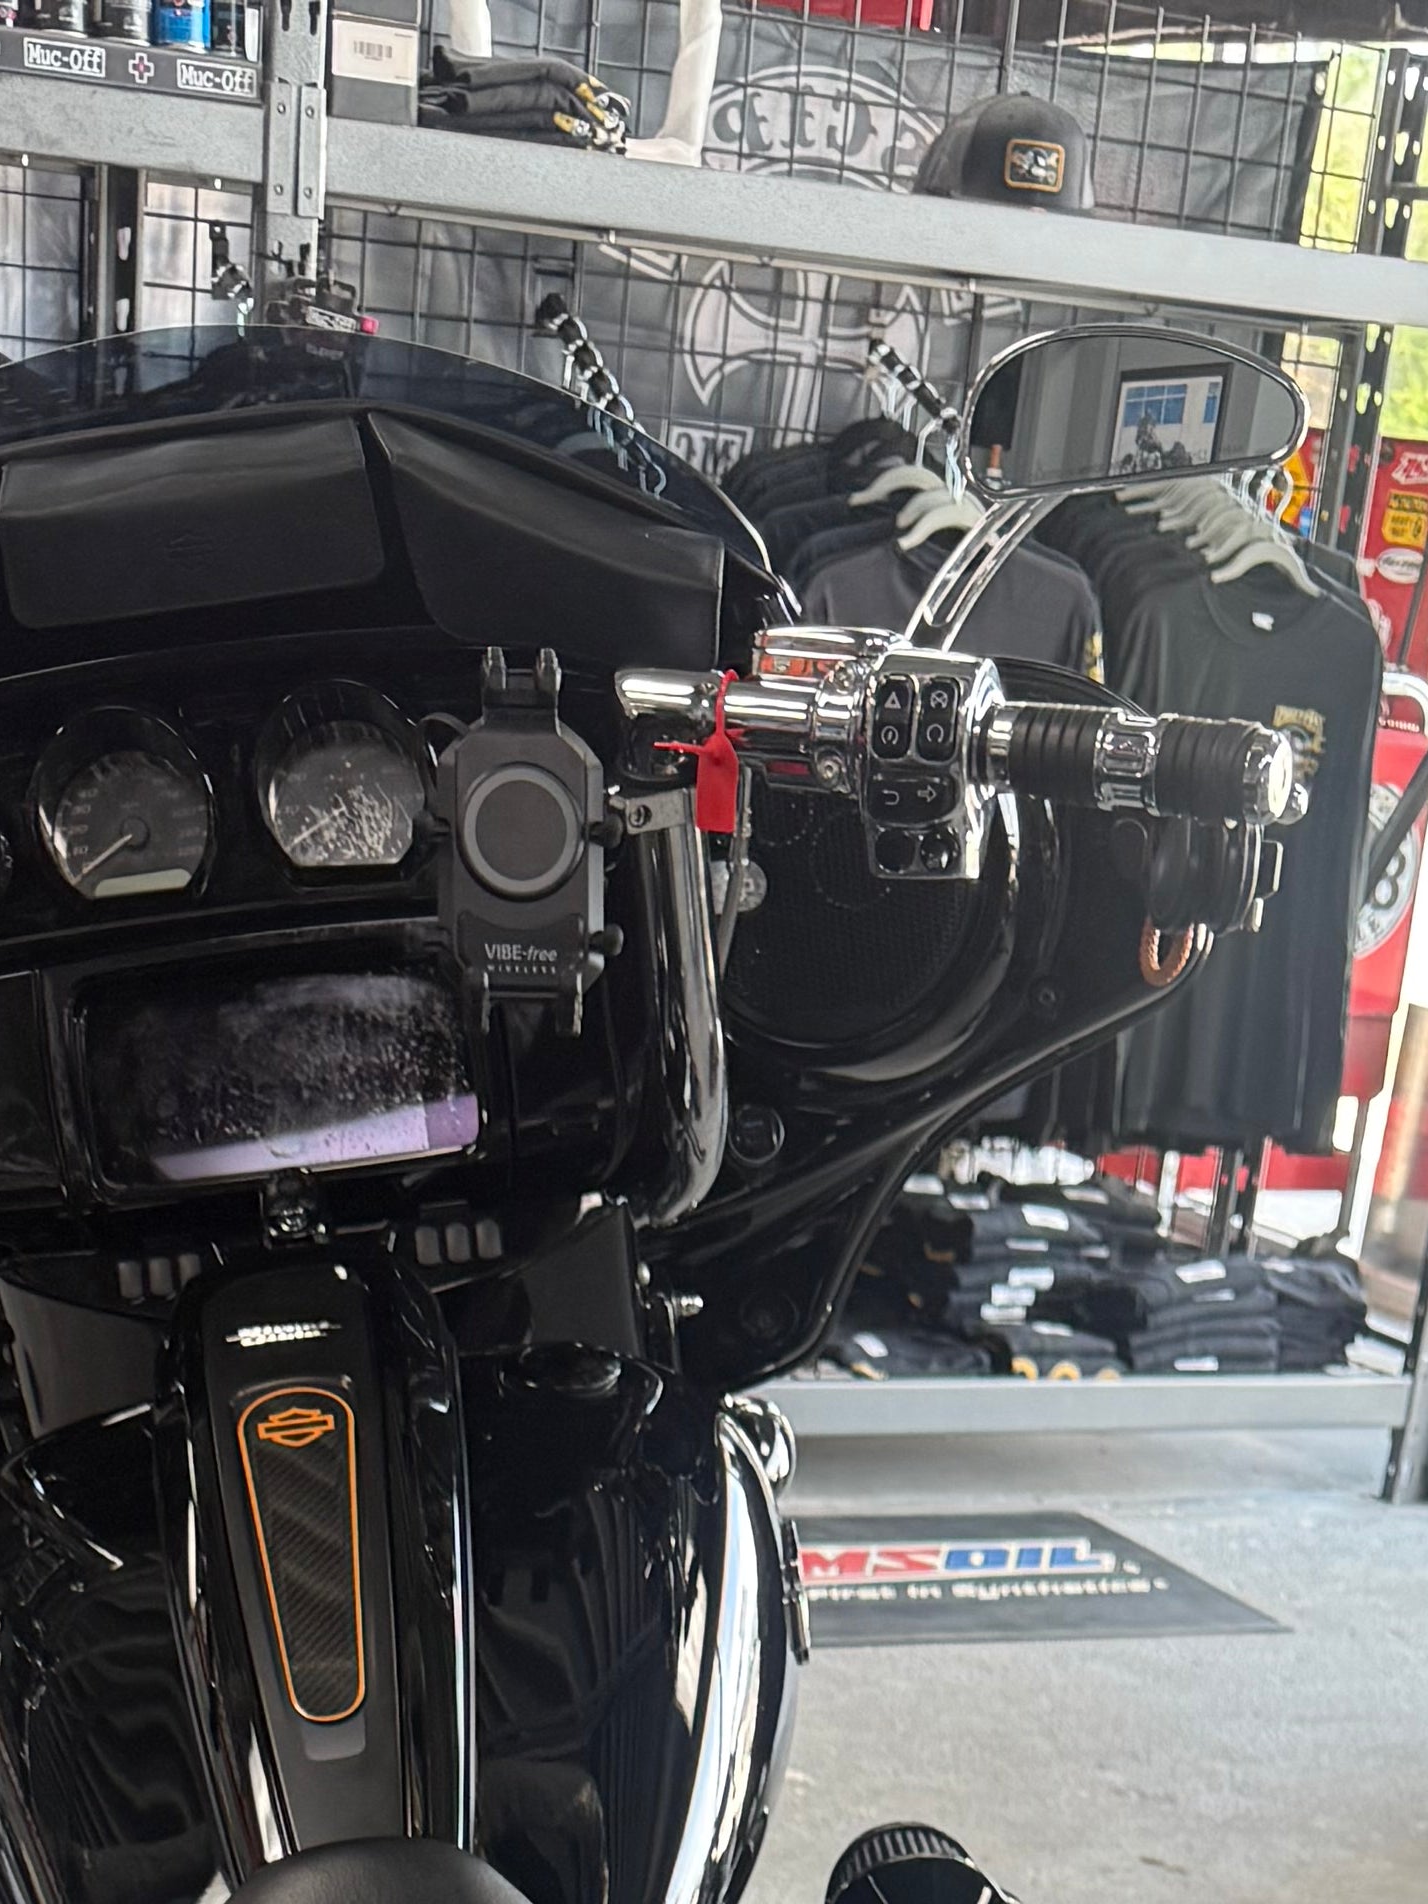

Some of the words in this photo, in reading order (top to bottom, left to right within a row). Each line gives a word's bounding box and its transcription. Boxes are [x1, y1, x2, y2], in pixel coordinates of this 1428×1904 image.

[27, 43, 103, 74] Muc-Off
[180, 66, 254, 95] Muc-Off
[484, 942, 558, 962] VIBE-free
[799, 1542, 1117, 1580] MSOIL
